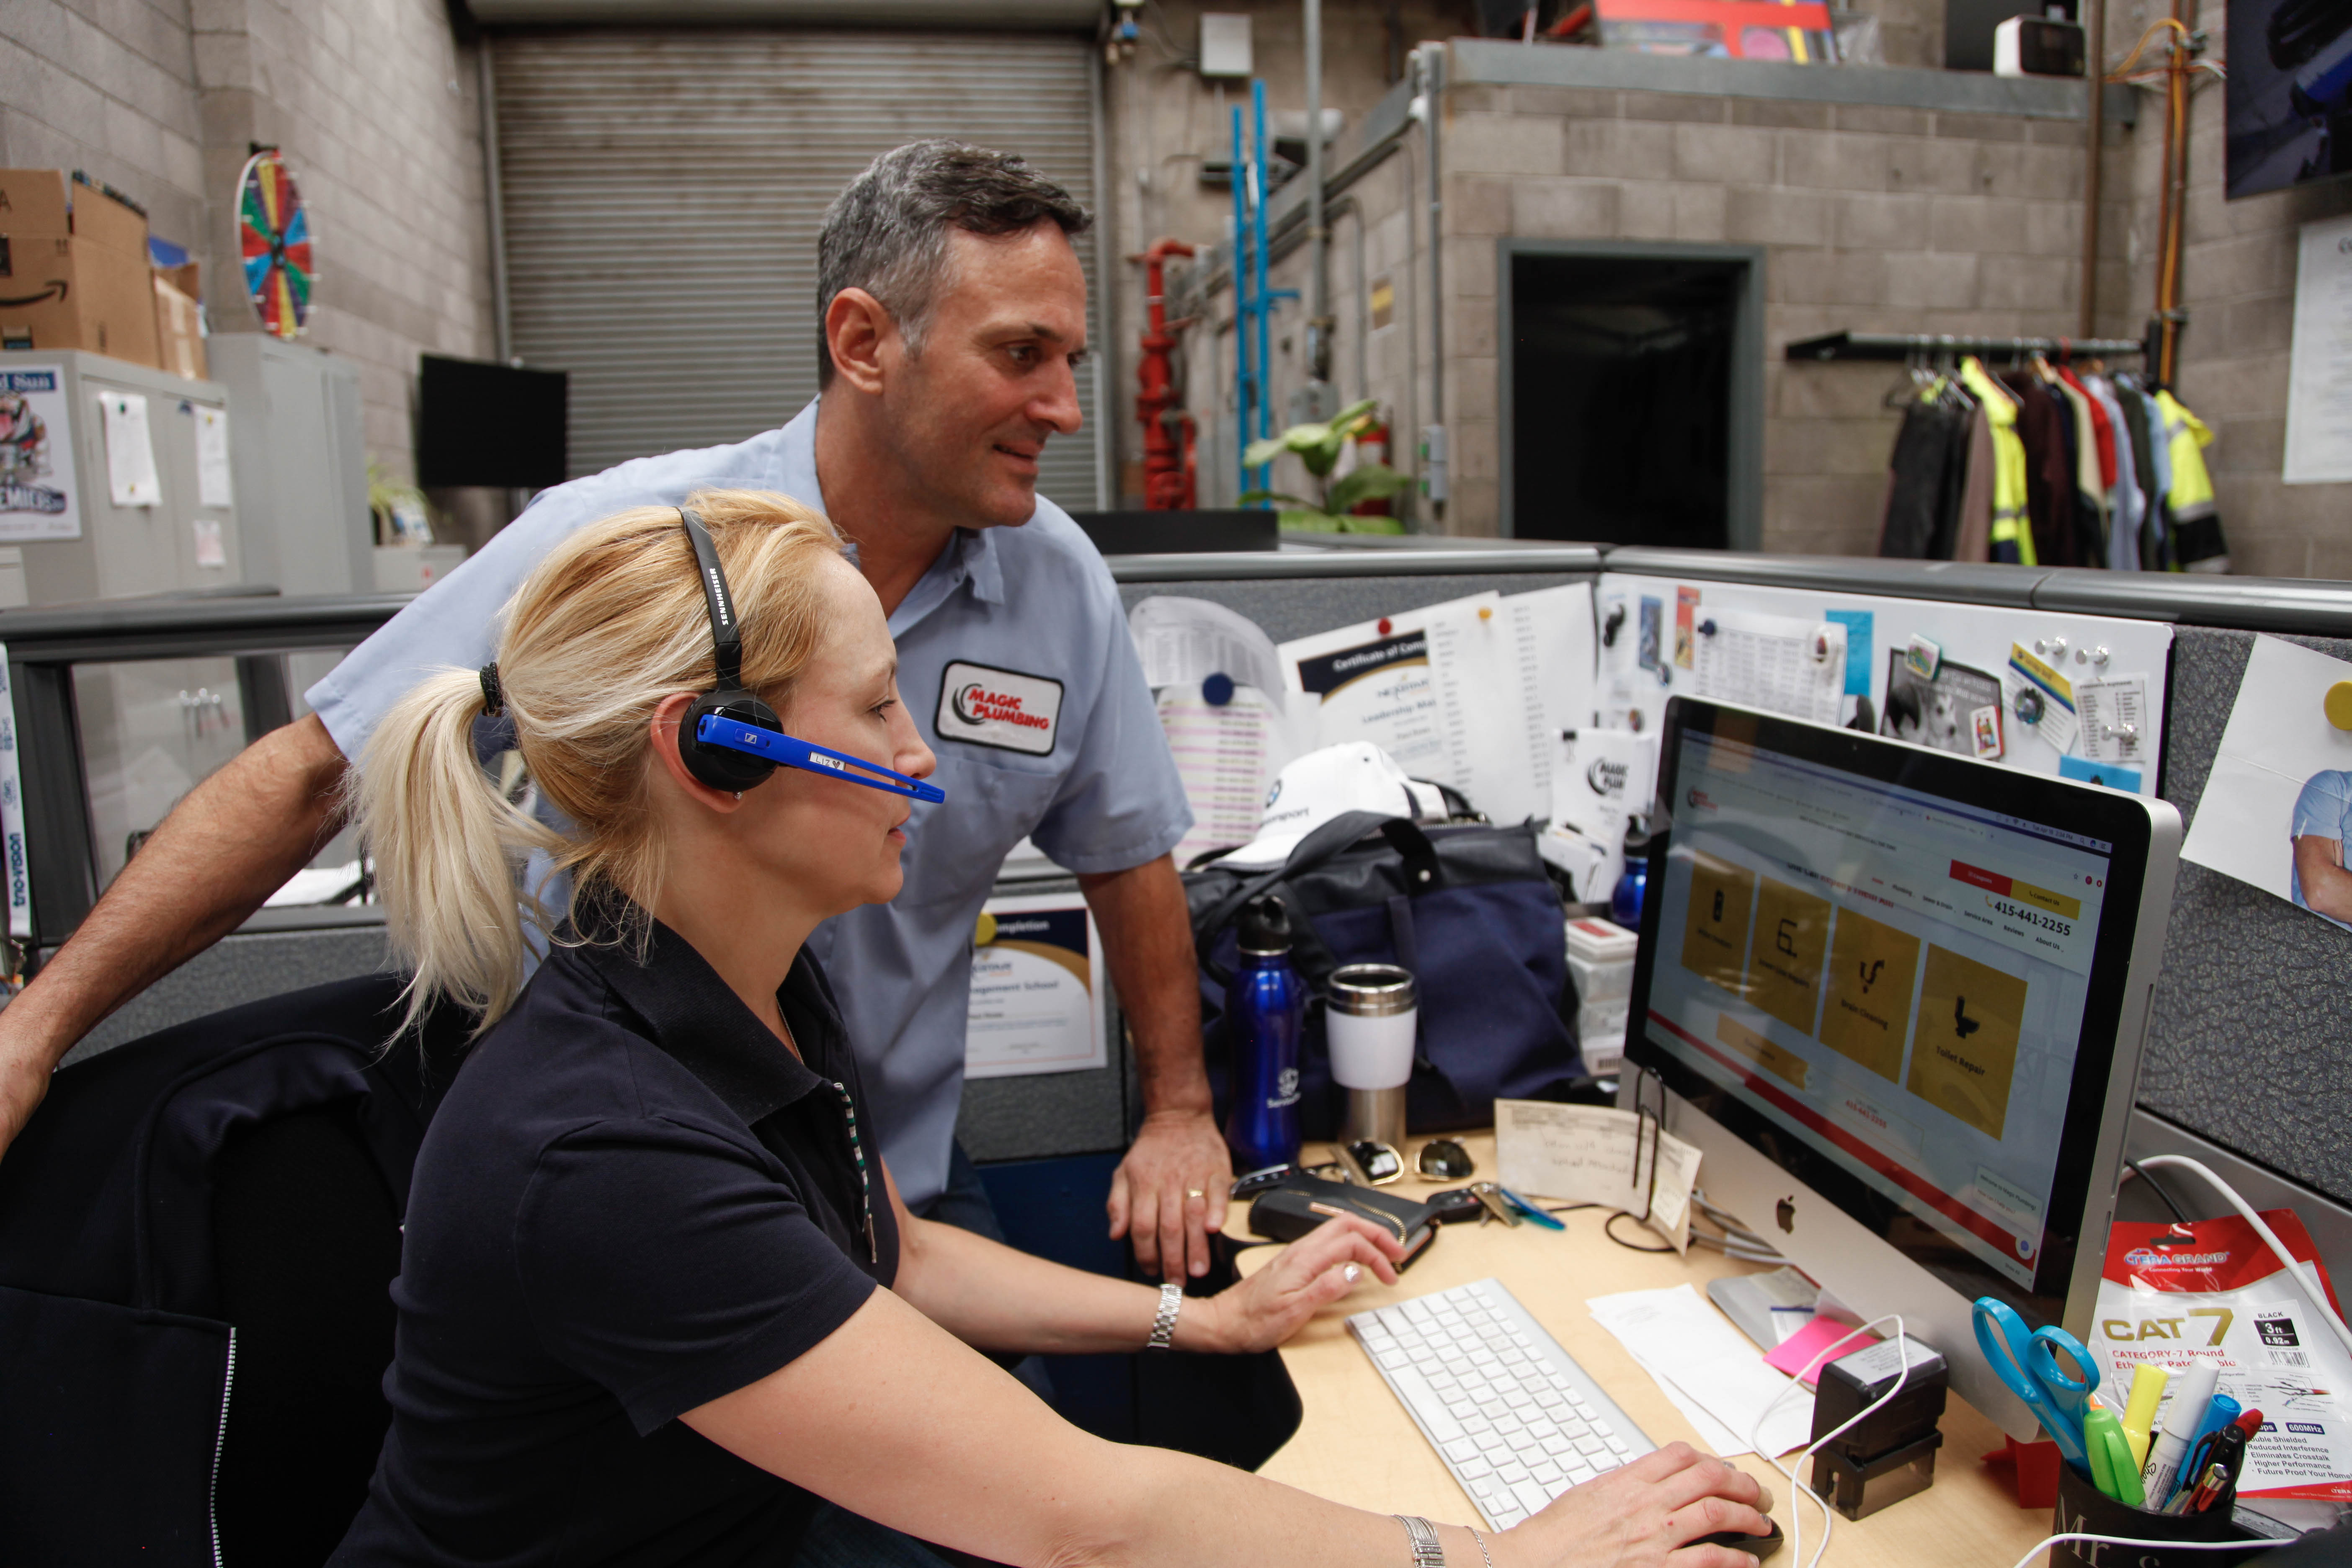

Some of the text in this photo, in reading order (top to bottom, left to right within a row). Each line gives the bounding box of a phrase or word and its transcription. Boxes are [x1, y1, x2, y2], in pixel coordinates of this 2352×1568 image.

[709, 568, 728, 625] SENNHEISER
[1332, 652, 1385, 671] Certificate
[1386, 645, 1398, 658] of
[969, 688, 1022, 709] MAGIC
[972, 703, 1049, 730] PLUMBING
[816, 755, 830, 766] LIZ
[2033, 892, 2060, 907] Contact Us
[1964, 910, 1994, 926] Service Area
[1994, 900, 2071, 937] 415-441-2255
[2003, 924, 2024, 937] Reviews
[2035, 936, 2060, 951] About Us
[1841, 998, 1888, 1031] Drain Cleaning
[1937, 1045, 1986, 1076] Toilet Repair
[2003, 1187, 2014, 1198] Magic
[2125, 1251, 2227, 1265] TERA GRAND
[2102, 1307, 2234, 1346] CAT 7
[2265, 1322, 2274, 1333] 3
[2112, 1349, 2183, 1359] CATEGORY-7
[2288, 1424, 2323, 1433] 600MHz
[2283, 1445, 2329, 1454] Interference
[2293, 1453, 2330, 1461] Crosstalk
[2282, 1461, 2331, 1470] Performance
[2308, 1469, 2326, 1478] Your
